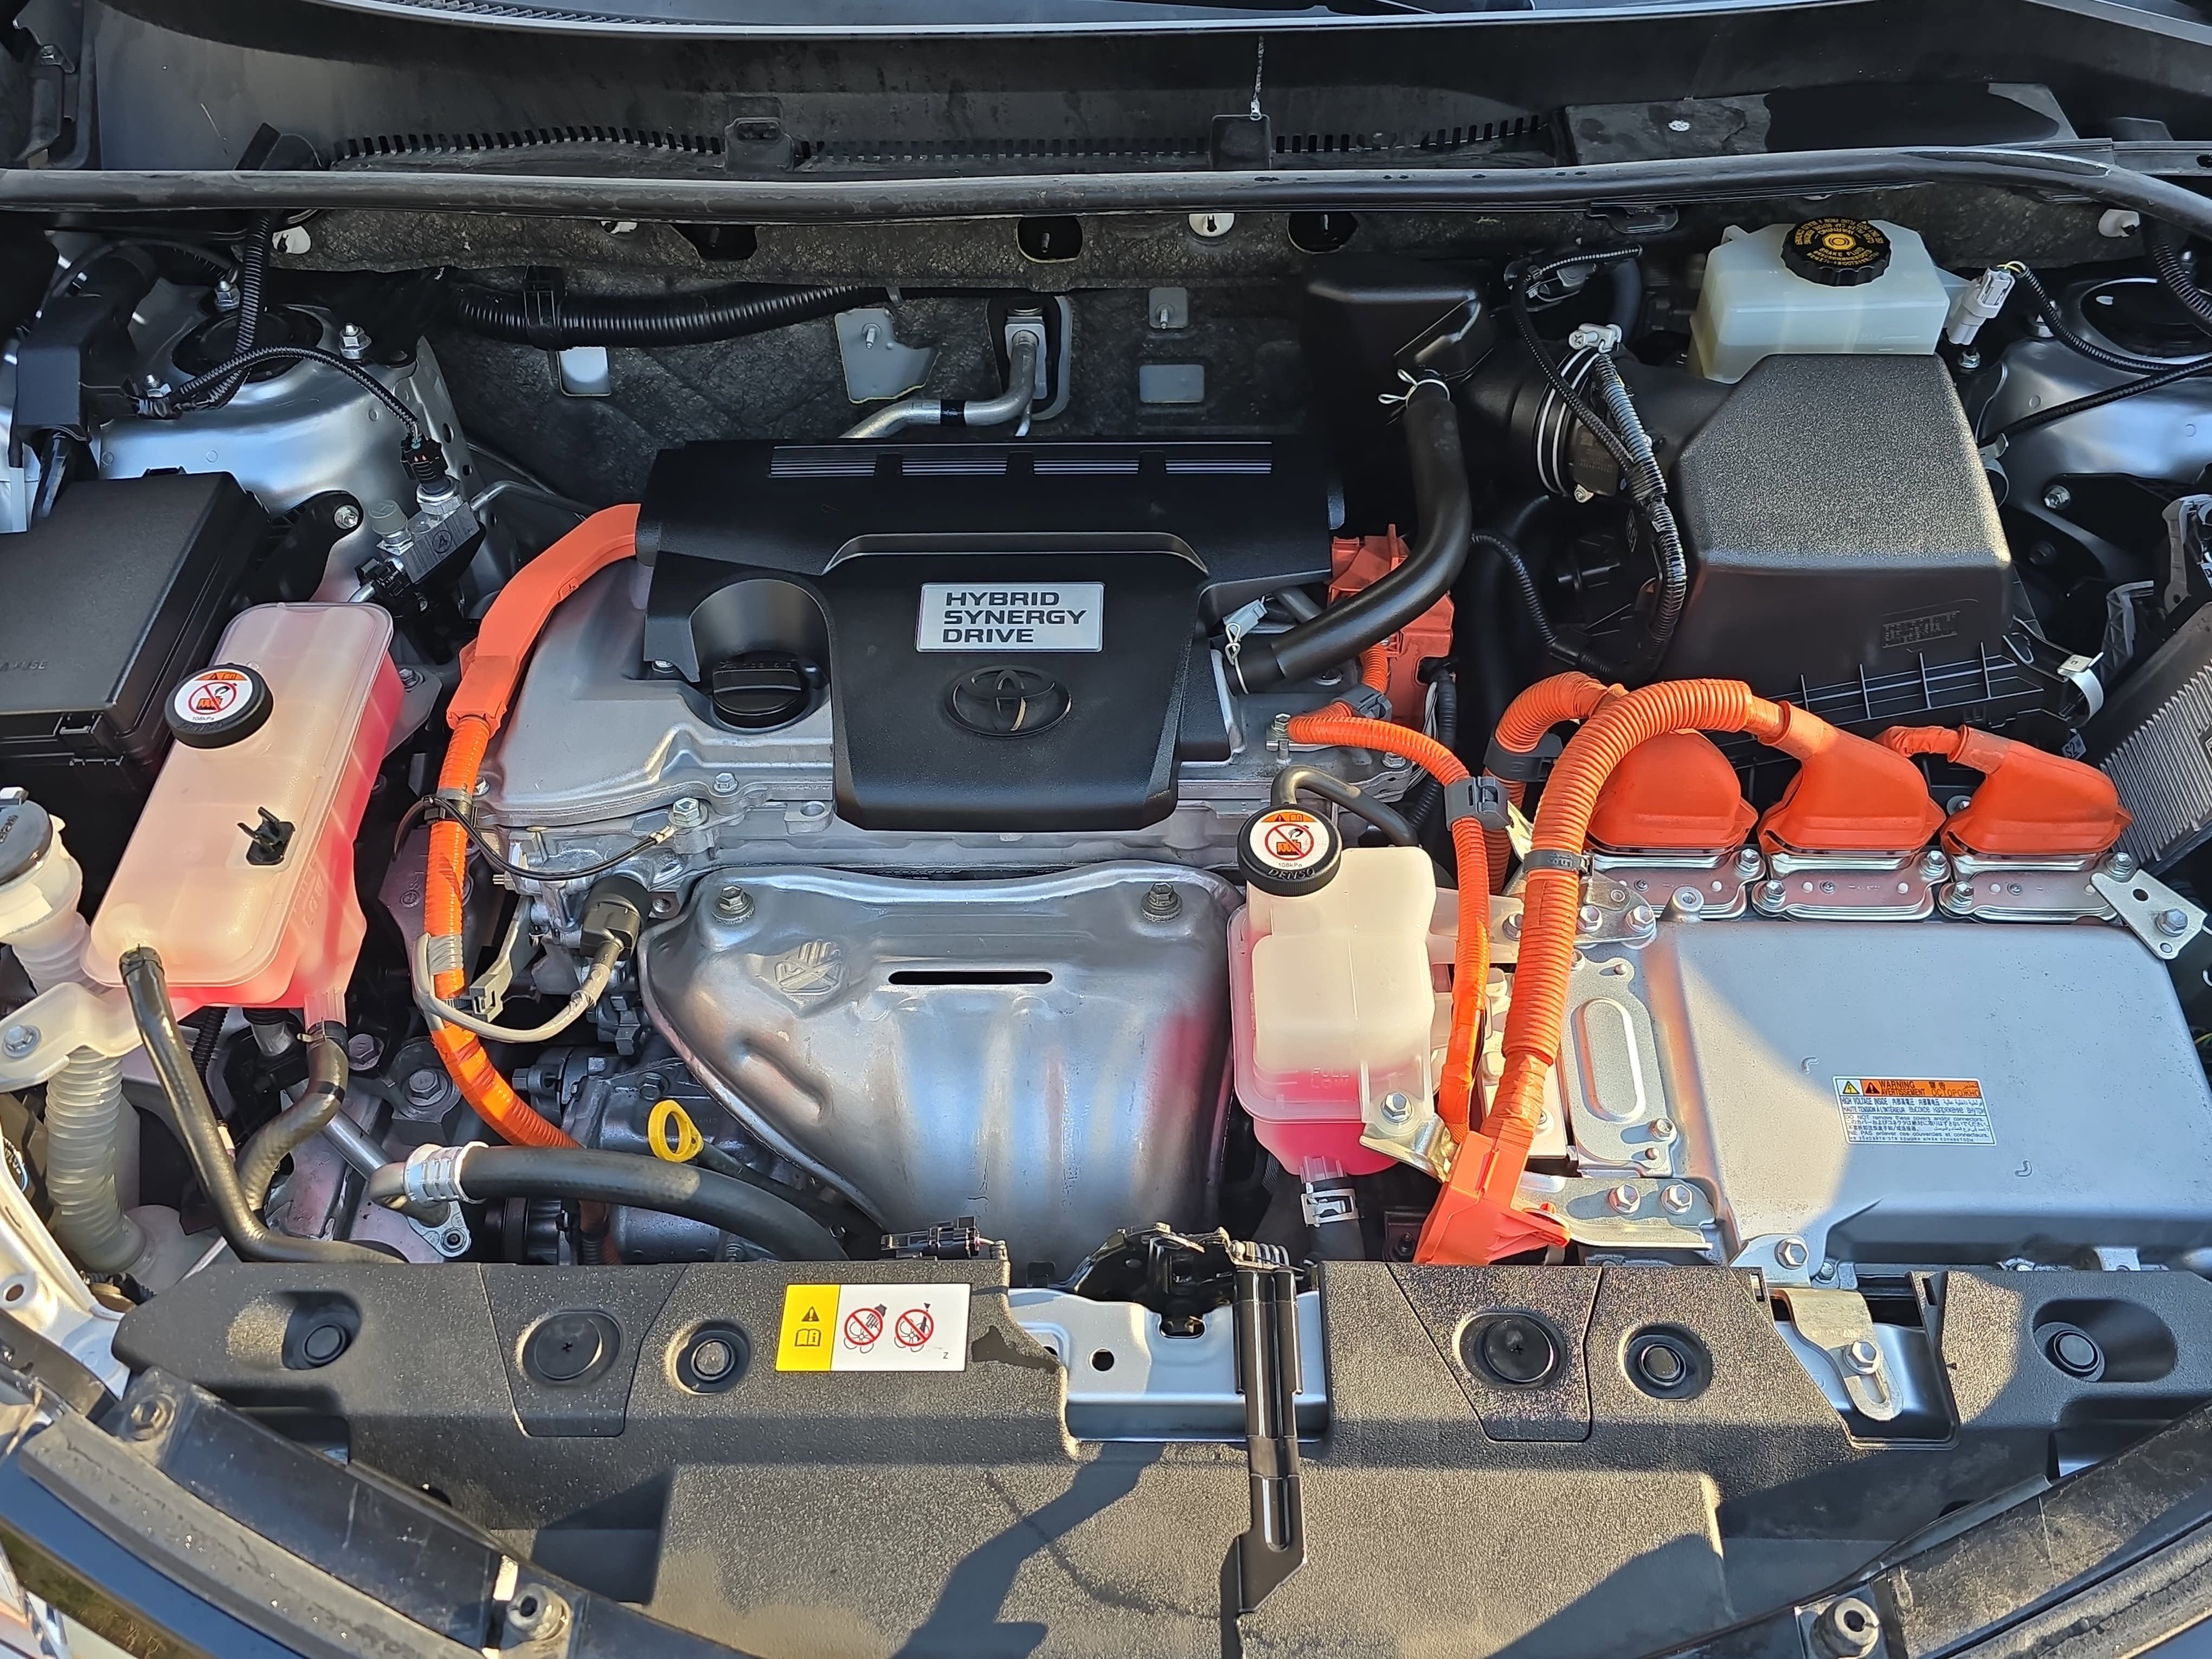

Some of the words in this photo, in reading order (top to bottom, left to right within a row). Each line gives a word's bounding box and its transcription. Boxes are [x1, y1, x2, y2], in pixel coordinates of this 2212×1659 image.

[1818, 247, 1842, 256] BRAKE
[1846, 247, 1864, 256] FLUID
[946, 592, 1059, 606] HYBRID
[944, 610, 1087, 625] SYNERGY
[942, 628, 1034, 643] DRIVE
[1268, 867, 1315, 880] DENSO
[1878, 1080, 1915, 1089] WARNING
[1931, 1088, 1980, 1097] ОСТОРОЖНО
